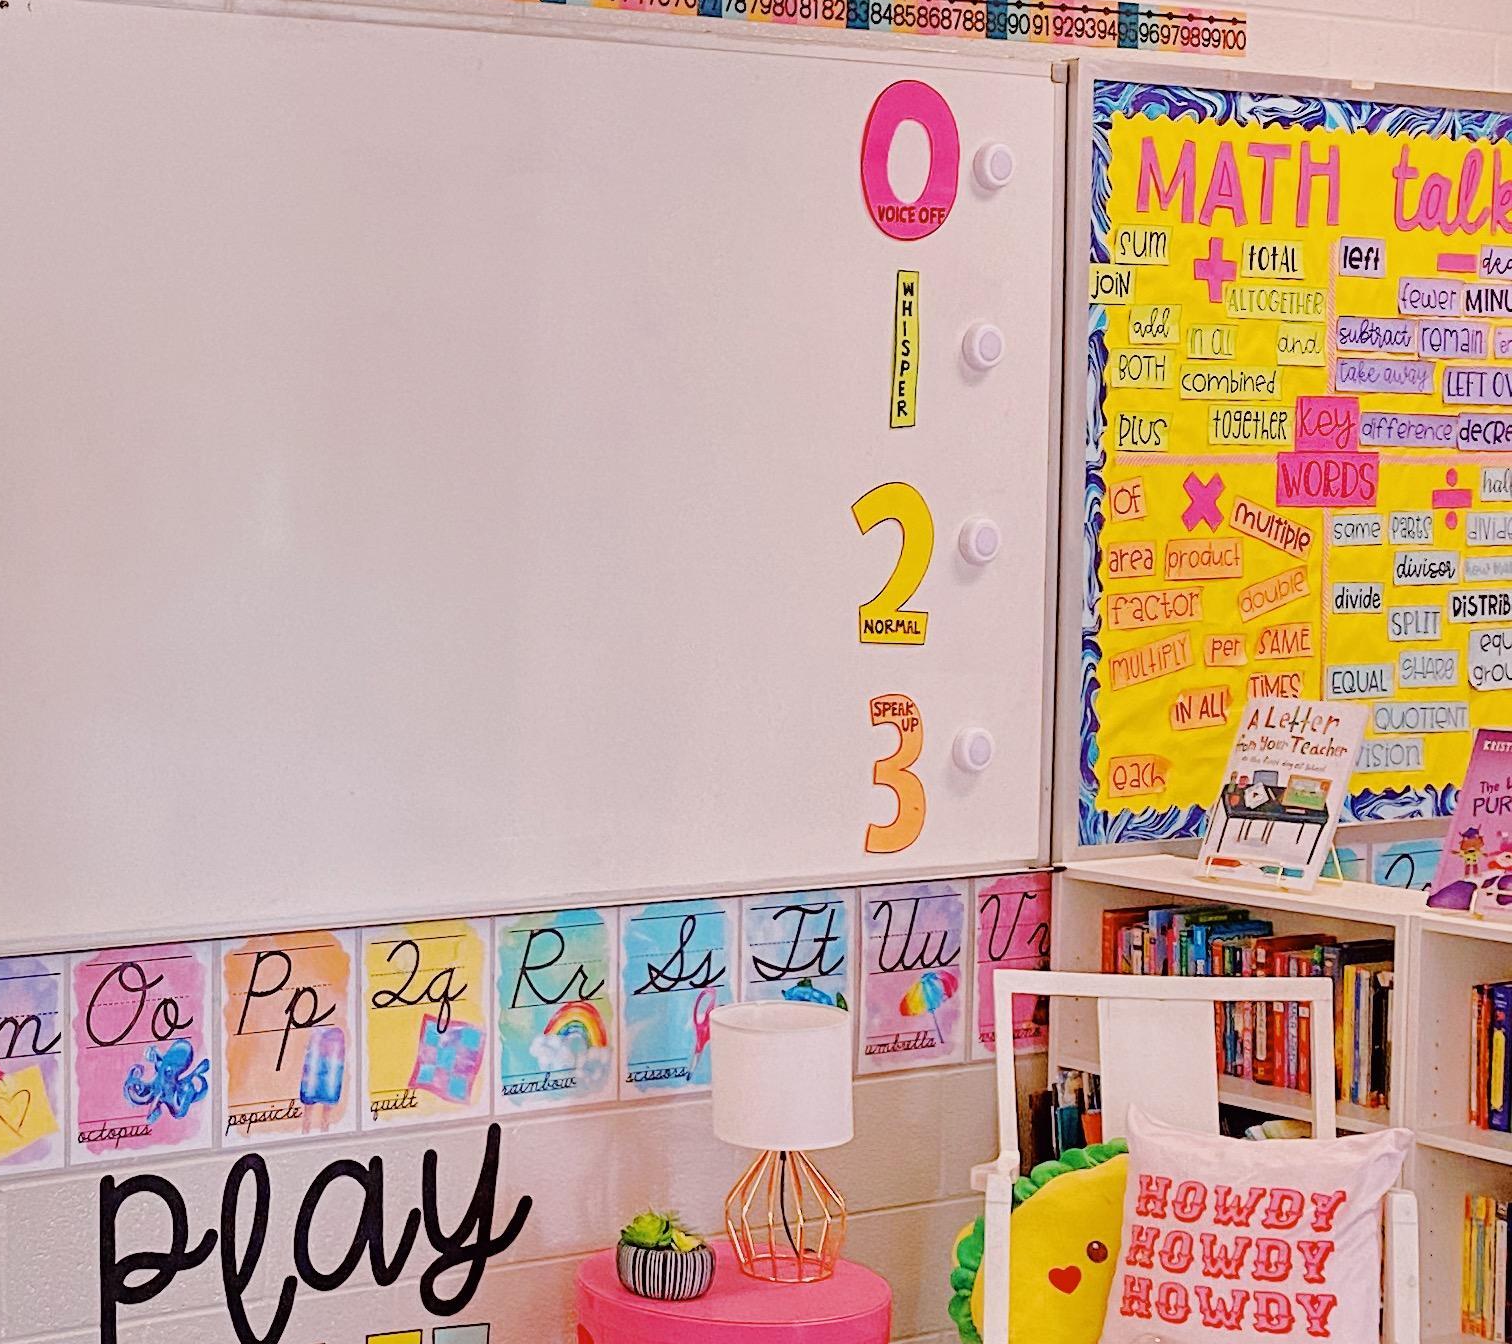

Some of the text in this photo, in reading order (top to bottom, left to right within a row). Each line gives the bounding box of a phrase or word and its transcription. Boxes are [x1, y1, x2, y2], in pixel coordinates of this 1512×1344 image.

[1008, 13, 1029, 34] 90
[1139, 23, 1159, 43] 96
[1202, 28, 1220, 48] 99
[1222, 29, 1246, 50] 100
[1136, 136, 1341, 228] MATH
[878, 205, 945, 224] VOICE OFF
[1120, 231, 1167, 257] sum
[1343, 245, 1379, 270] left
[1228, 289, 1325, 315] ALTOGETHER
[1401, 282, 1456, 309] fewer
[1133, 307, 1170, 337] add
[1339, 320, 1411, 347] subtract
[896, 280, 913, 420] WHISPER
[1278, 334, 1322, 354] and
[1422, 327, 1483, 352] remain
[1119, 355, 1166, 381] BOTH
[1340, 362, 1429, 391] take away
[1182, 370, 1276, 394] combined
[1447, 371, 1487, 397] LEFT
[1362, 418, 1452, 440] difference
[1282, 461, 1377, 500] WORDS
[1235, 503, 1310, 553] multiple
[1109, 549, 1154, 573] area
[1168, 543, 1240, 576] product
[1396, 555, 1456, 579] divisor
[1241, 571, 1305, 613] double
[1335, 587, 1381, 609] divide
[864, 619, 920, 634] NORMAL
[1392, 611, 1440, 635] SPLIT
[1212, 638, 1240, 662] per
[1258, 629, 1311, 655] SAME
[1333, 669, 1387, 694] EQUAL
[874, 702, 914, 717] SPEAK
[1248, 706, 1339, 734] A Letter
[1375, 706, 1467, 730] QUOTIENT
[901, 718, 919, 732] UP
[1291, 735, 1347, 756] Teacher
[1113, 763, 1165, 790] each
[873, 897, 960, 972] Uu
[512, 929, 604, 1008] Rr
[87, 961, 193, 1048] Oo
[238, 950, 335, 1072] Pp
[865, 1034, 937, 1055] umbrella
[502, 1072, 576, 1096] rainbow
[626, 1065, 692, 1083] scissors
[226, 1100, 302, 1136] popsicle
[370, 1092, 418, 1125] quilt
[78, 1123, 152, 1148] octopus
[1135, 1174, 1347, 1233] HOWDY
[1125, 1225, 1335, 1285] HOWDY
[1120, 1275, 1337, 1338] HOWDY
